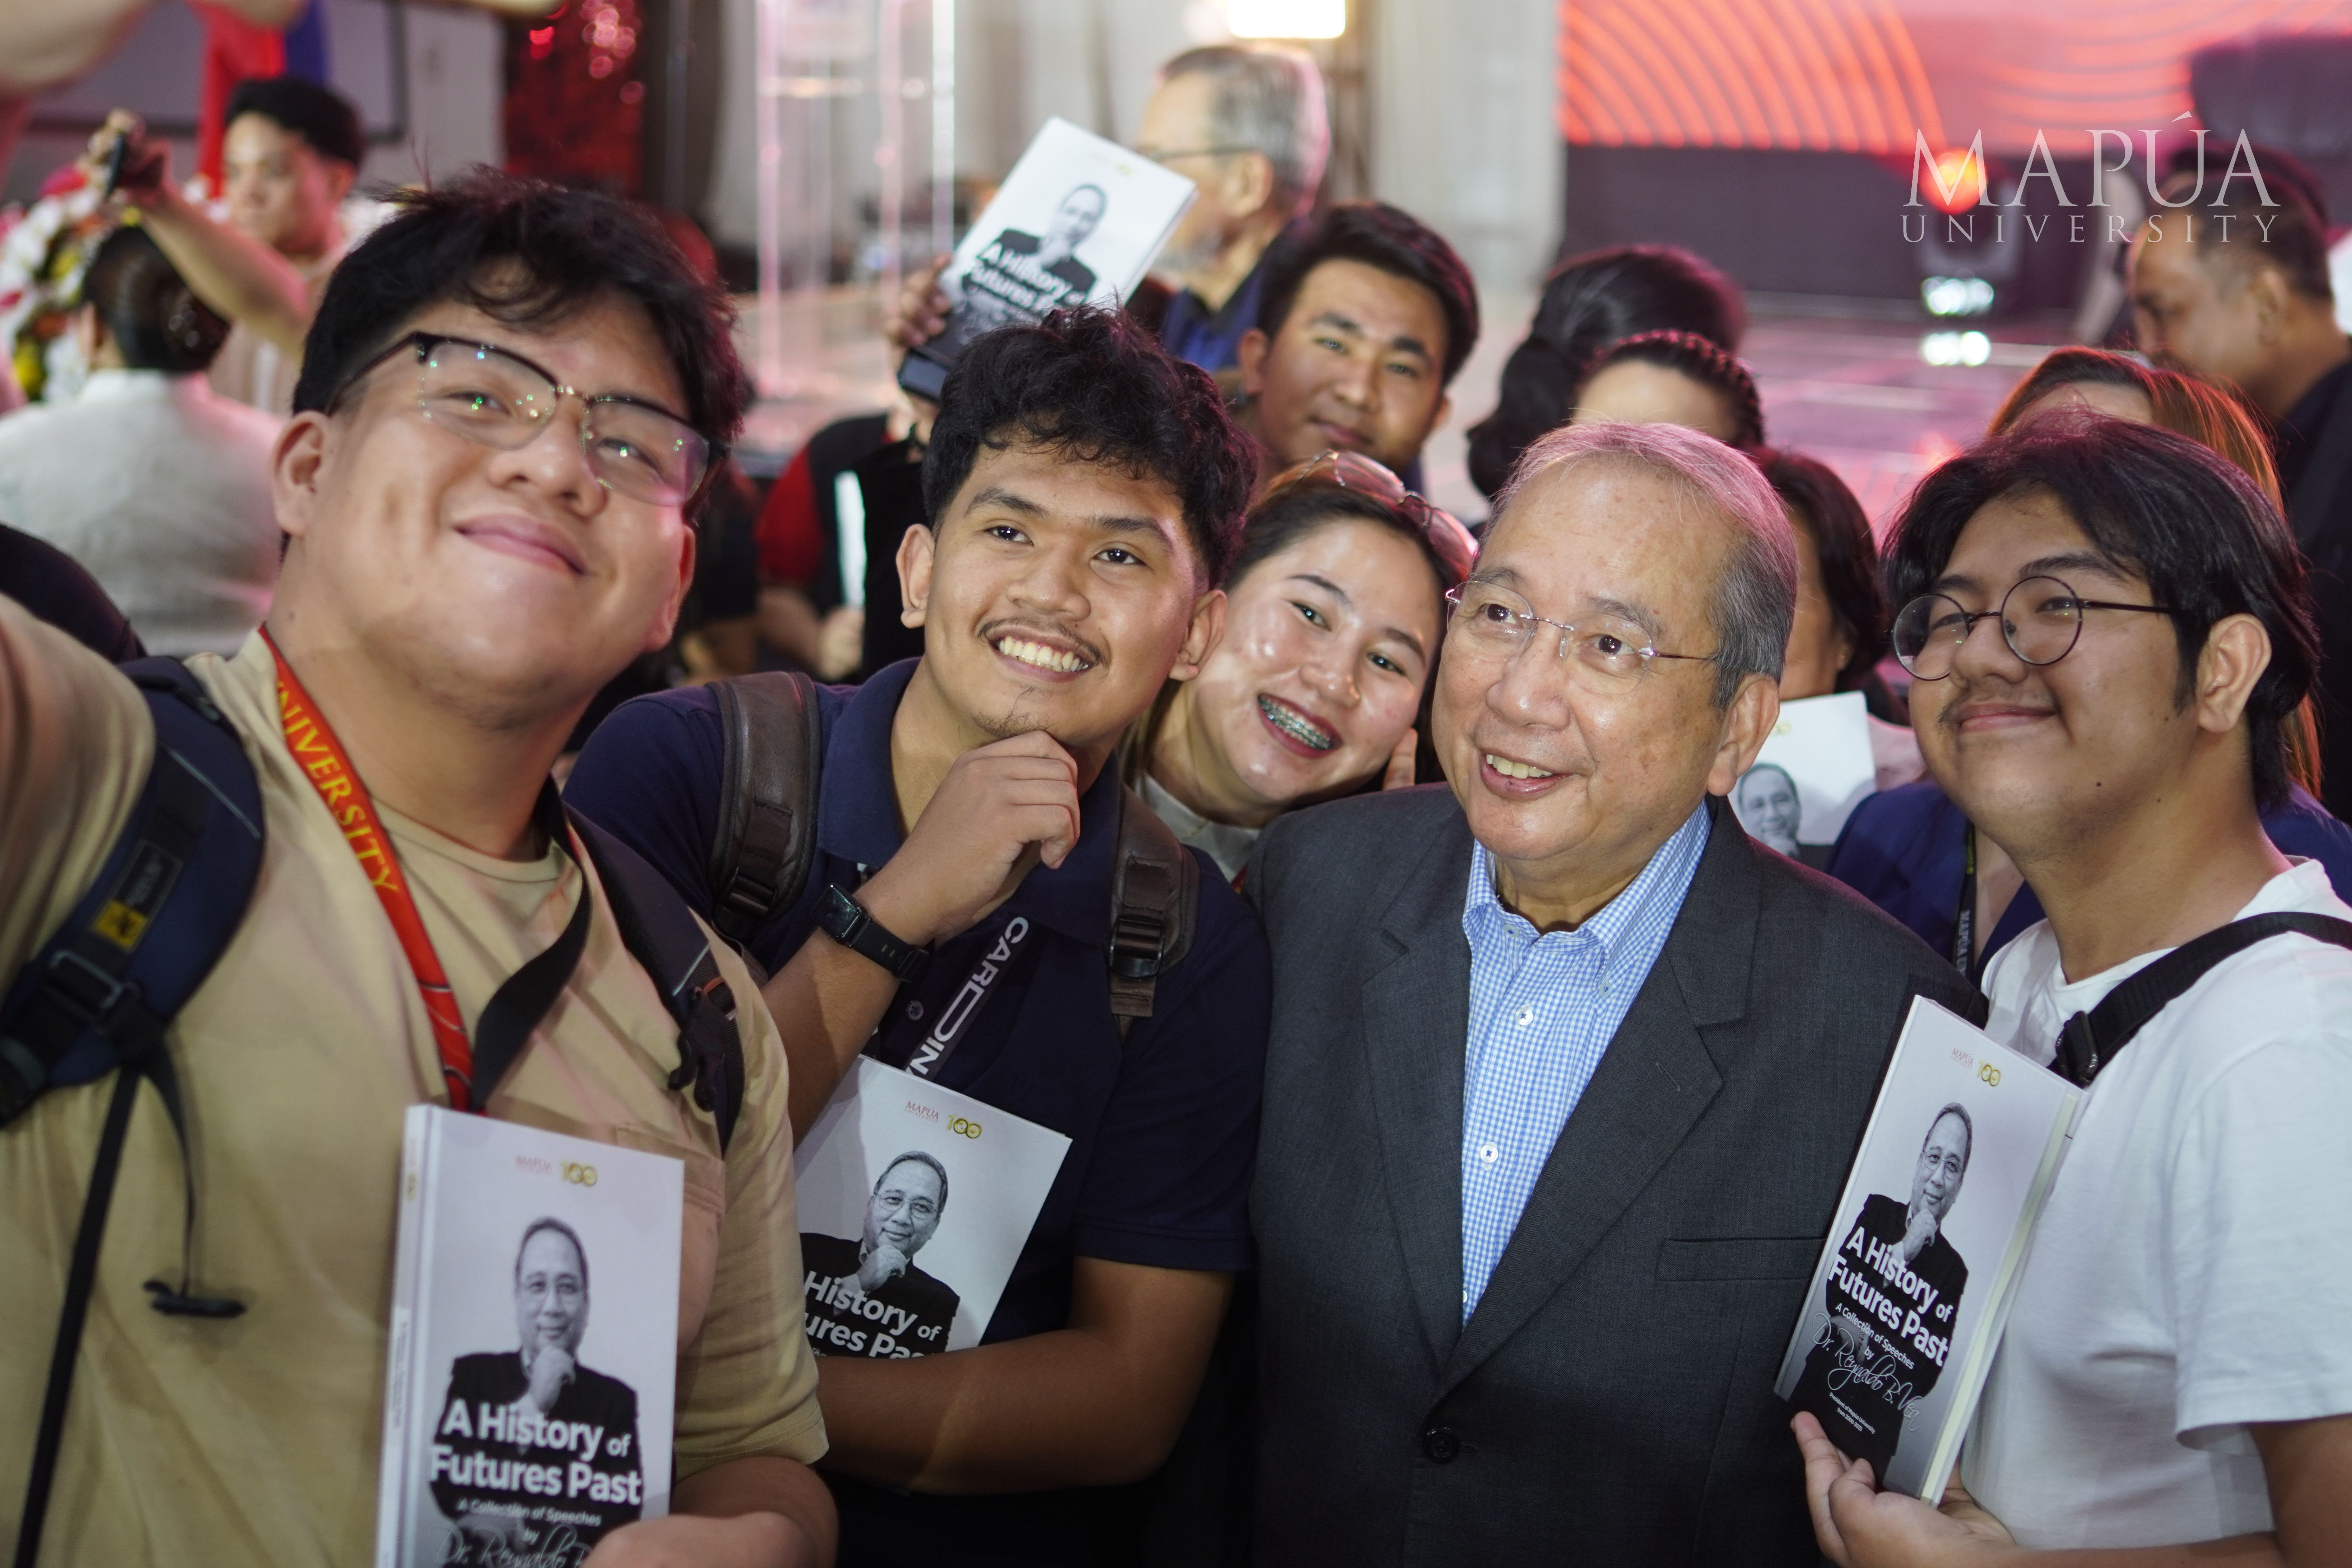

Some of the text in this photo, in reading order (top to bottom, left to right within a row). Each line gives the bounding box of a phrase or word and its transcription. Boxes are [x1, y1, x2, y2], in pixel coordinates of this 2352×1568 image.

[981, 242, 1002, 265] A
[998, 249, 1073, 303] History
[278, 681, 399, 893] NIVERSITY
[905, 916, 1029, 1076] CARDIN
[906, 1101, 939, 1120] MAPÚA
[947, 1114, 982, 1138] 100
[1846, 1226, 1954, 1323] A History of
[805, 1270, 942, 1341] History of
[805, 1312, 926, 1359] ures Pa
[1812, 1312, 1834, 1351] Dr.
[1828, 1253, 1949, 1367] Futures Past
[1835, 1303, 1915, 1370] A Collection of Speeches
[1864, 1346, 1875, 1360] by
[442, 1398, 632, 1462] A History of
[1829, 1392, 1845, 1408] President
[430, 1444, 642, 1506] Futures Past
[471, 1498, 530, 1519] Collection
[531, 1506, 547, 1521] of
[547, 1507, 602, 1527] Speeches
[524, 1527, 541, 1545] by
